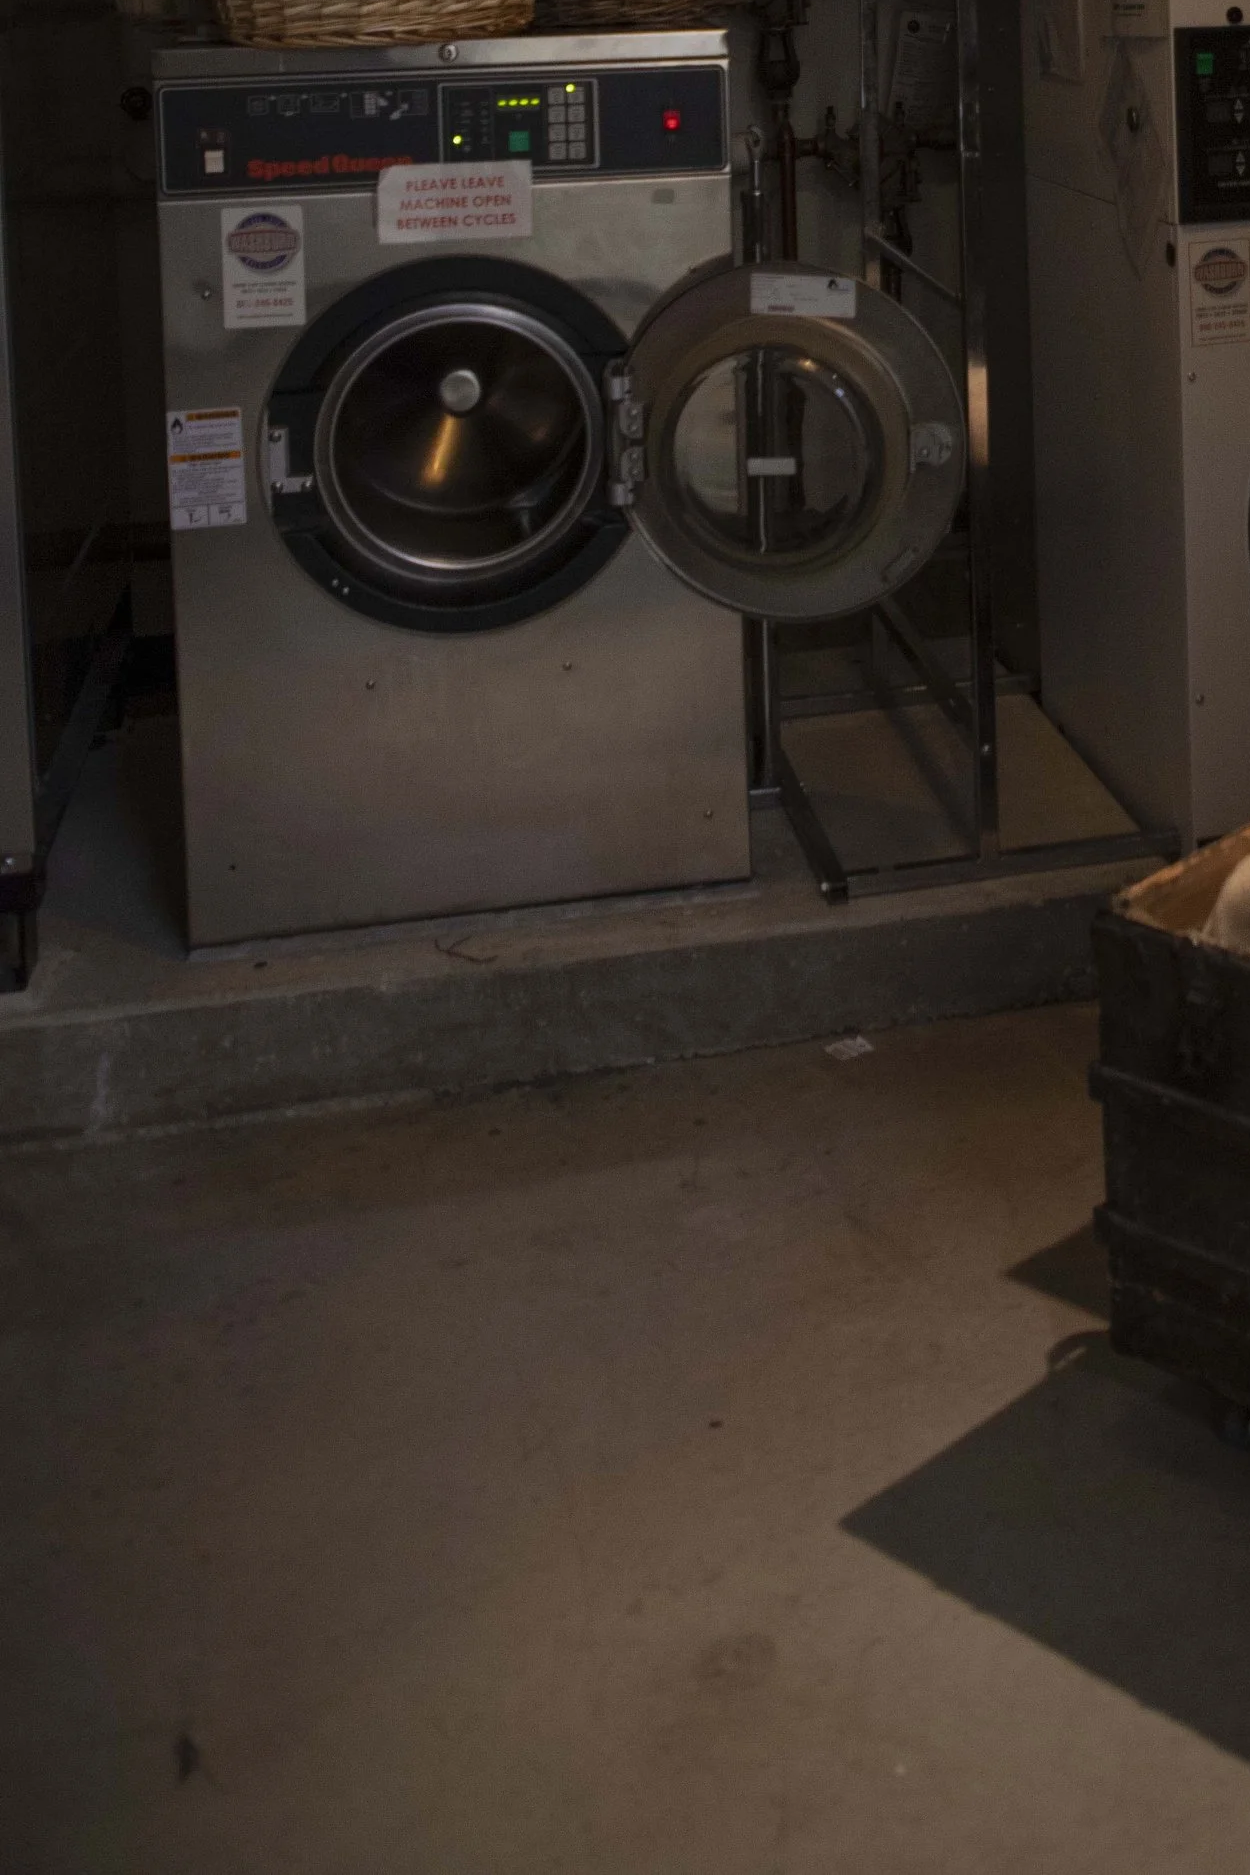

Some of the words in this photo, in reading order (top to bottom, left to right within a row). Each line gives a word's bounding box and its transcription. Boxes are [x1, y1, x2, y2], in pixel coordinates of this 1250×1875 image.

[247, 155, 330, 181] Speed
[462, 176, 505, 190] LEAVE
[400, 195, 468, 211] MACHINE
[472, 194, 511, 208] OPEN
[397, 215, 458, 230] BETWEEN
[462, 212, 516, 227] CYCLES
